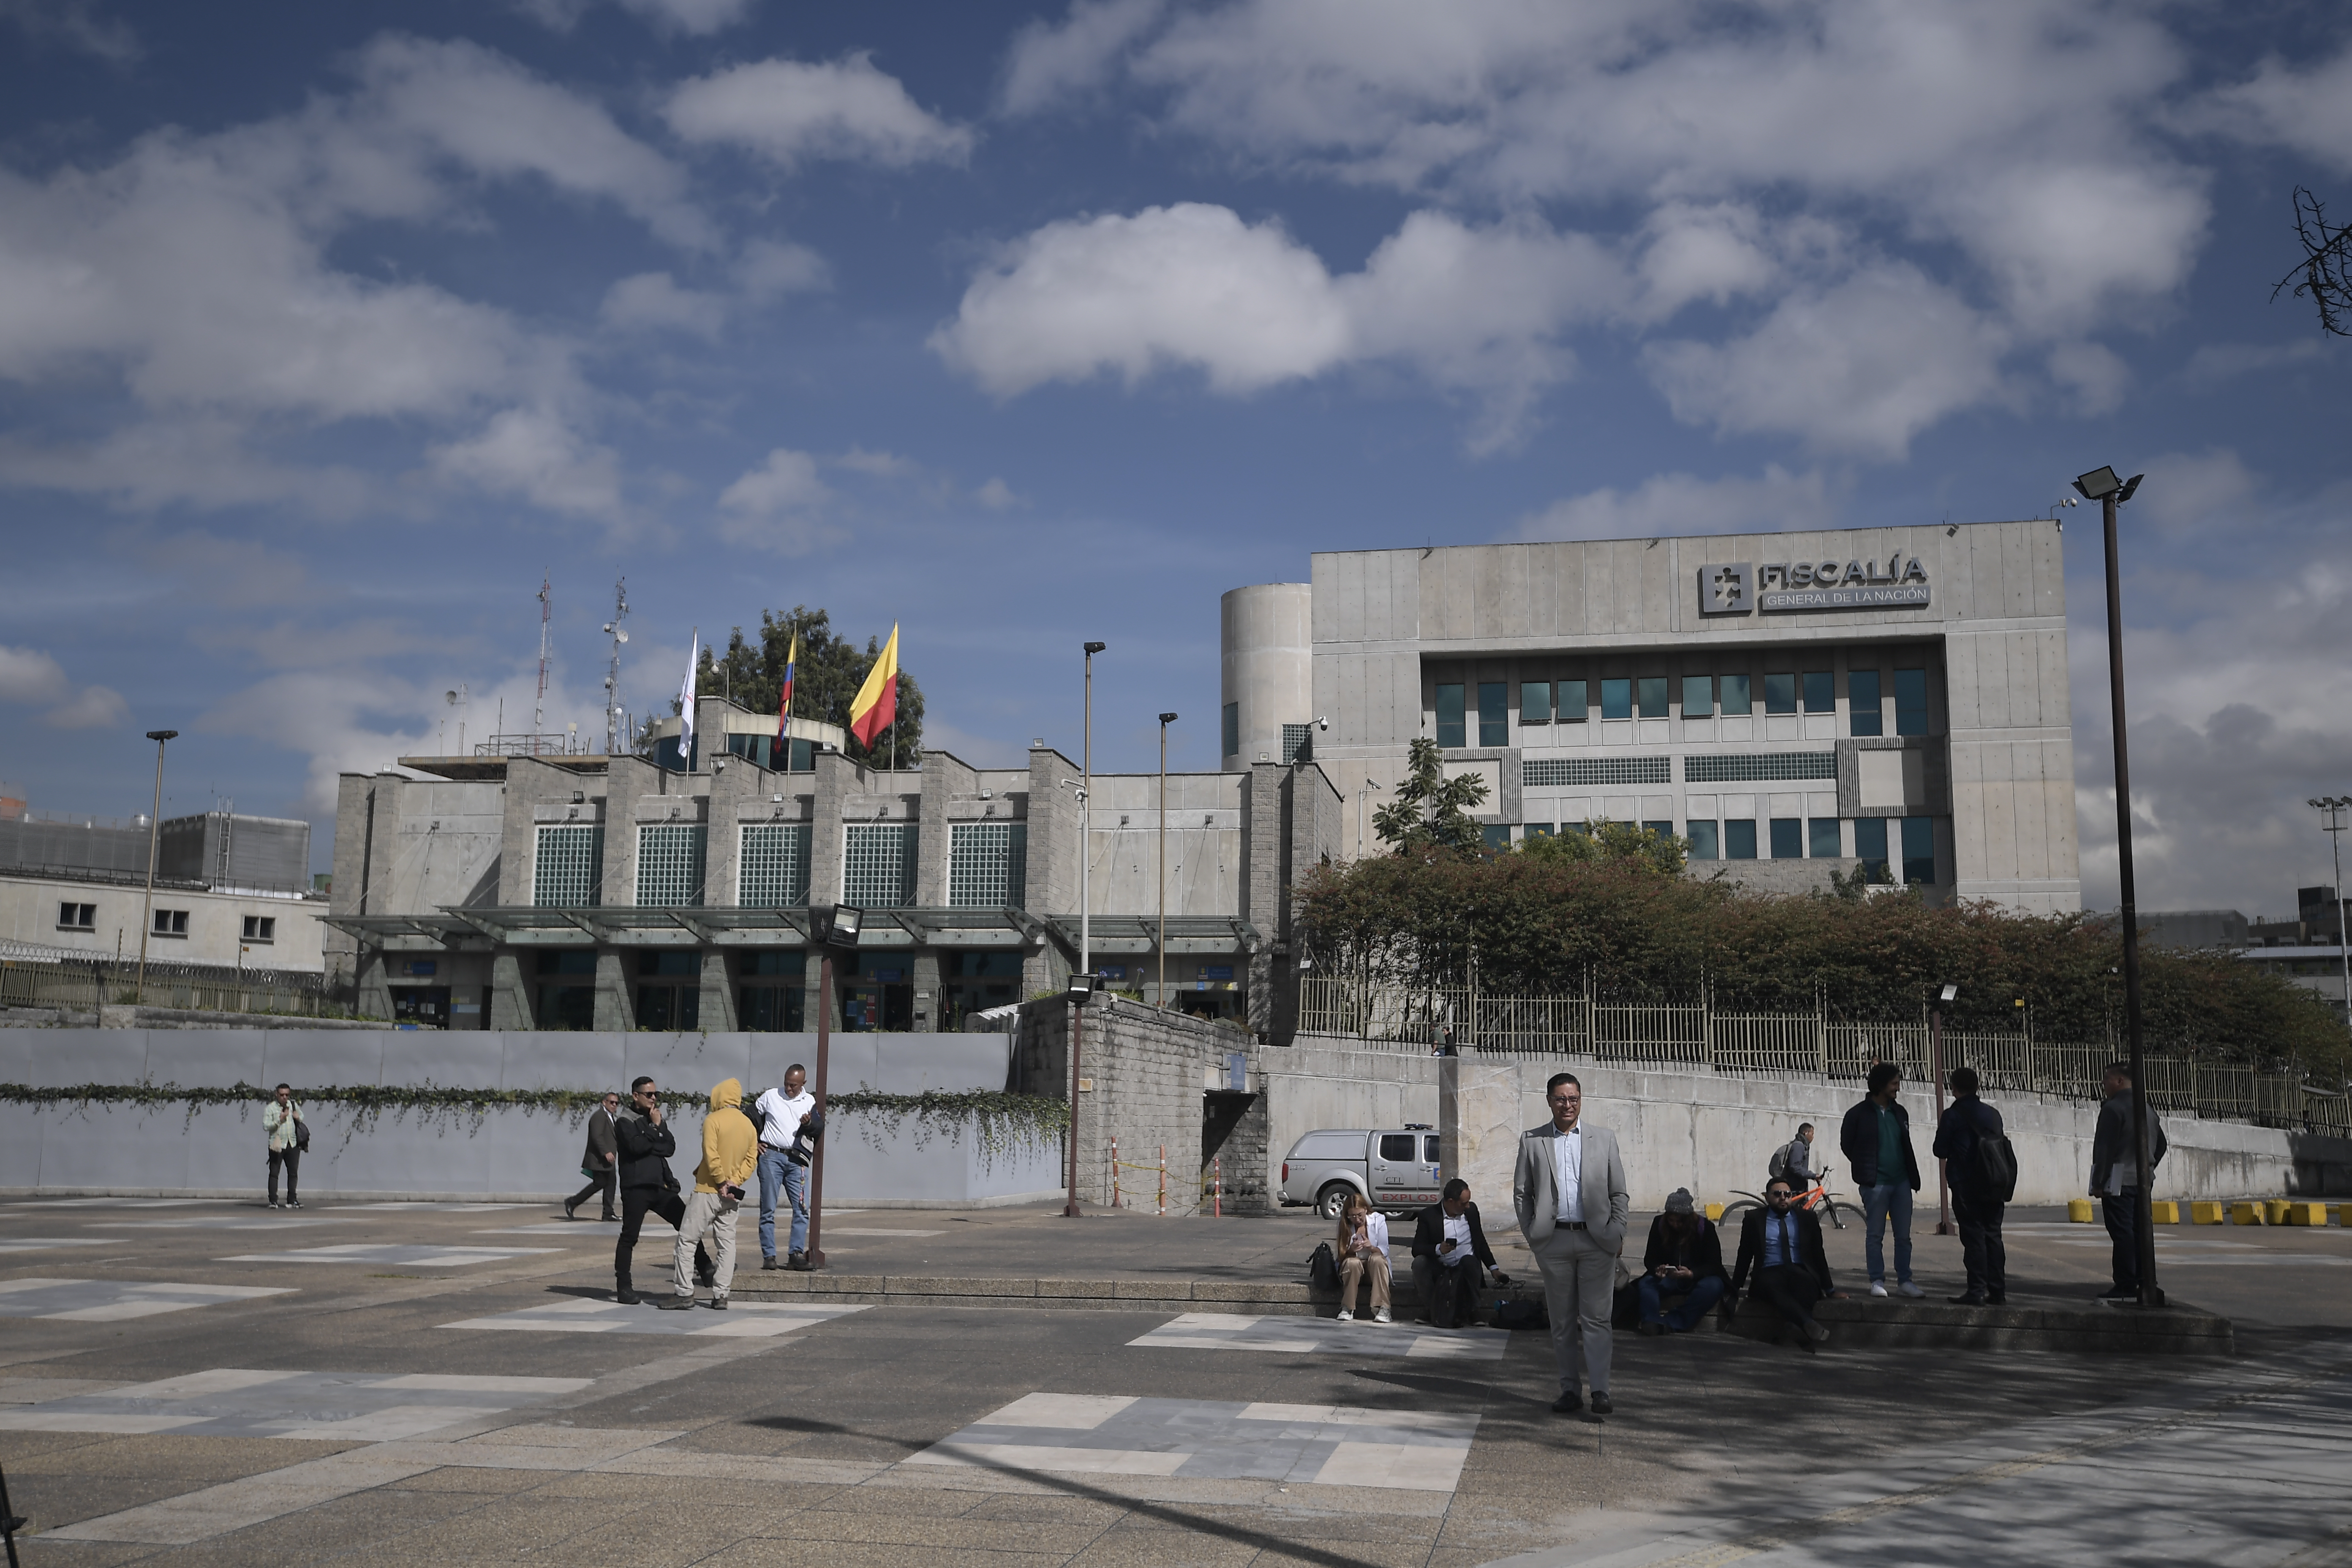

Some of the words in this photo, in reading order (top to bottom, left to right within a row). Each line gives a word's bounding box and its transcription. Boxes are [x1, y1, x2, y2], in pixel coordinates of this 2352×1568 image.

[1762, 549, 1929, 584] FISCALÍA
[1767, 594, 1829, 605] GENERAL
[1834, 593, 1851, 602] DE
[1856, 592, 1871, 602] LA
[1875, 587, 1927, 601] NACIÓN
